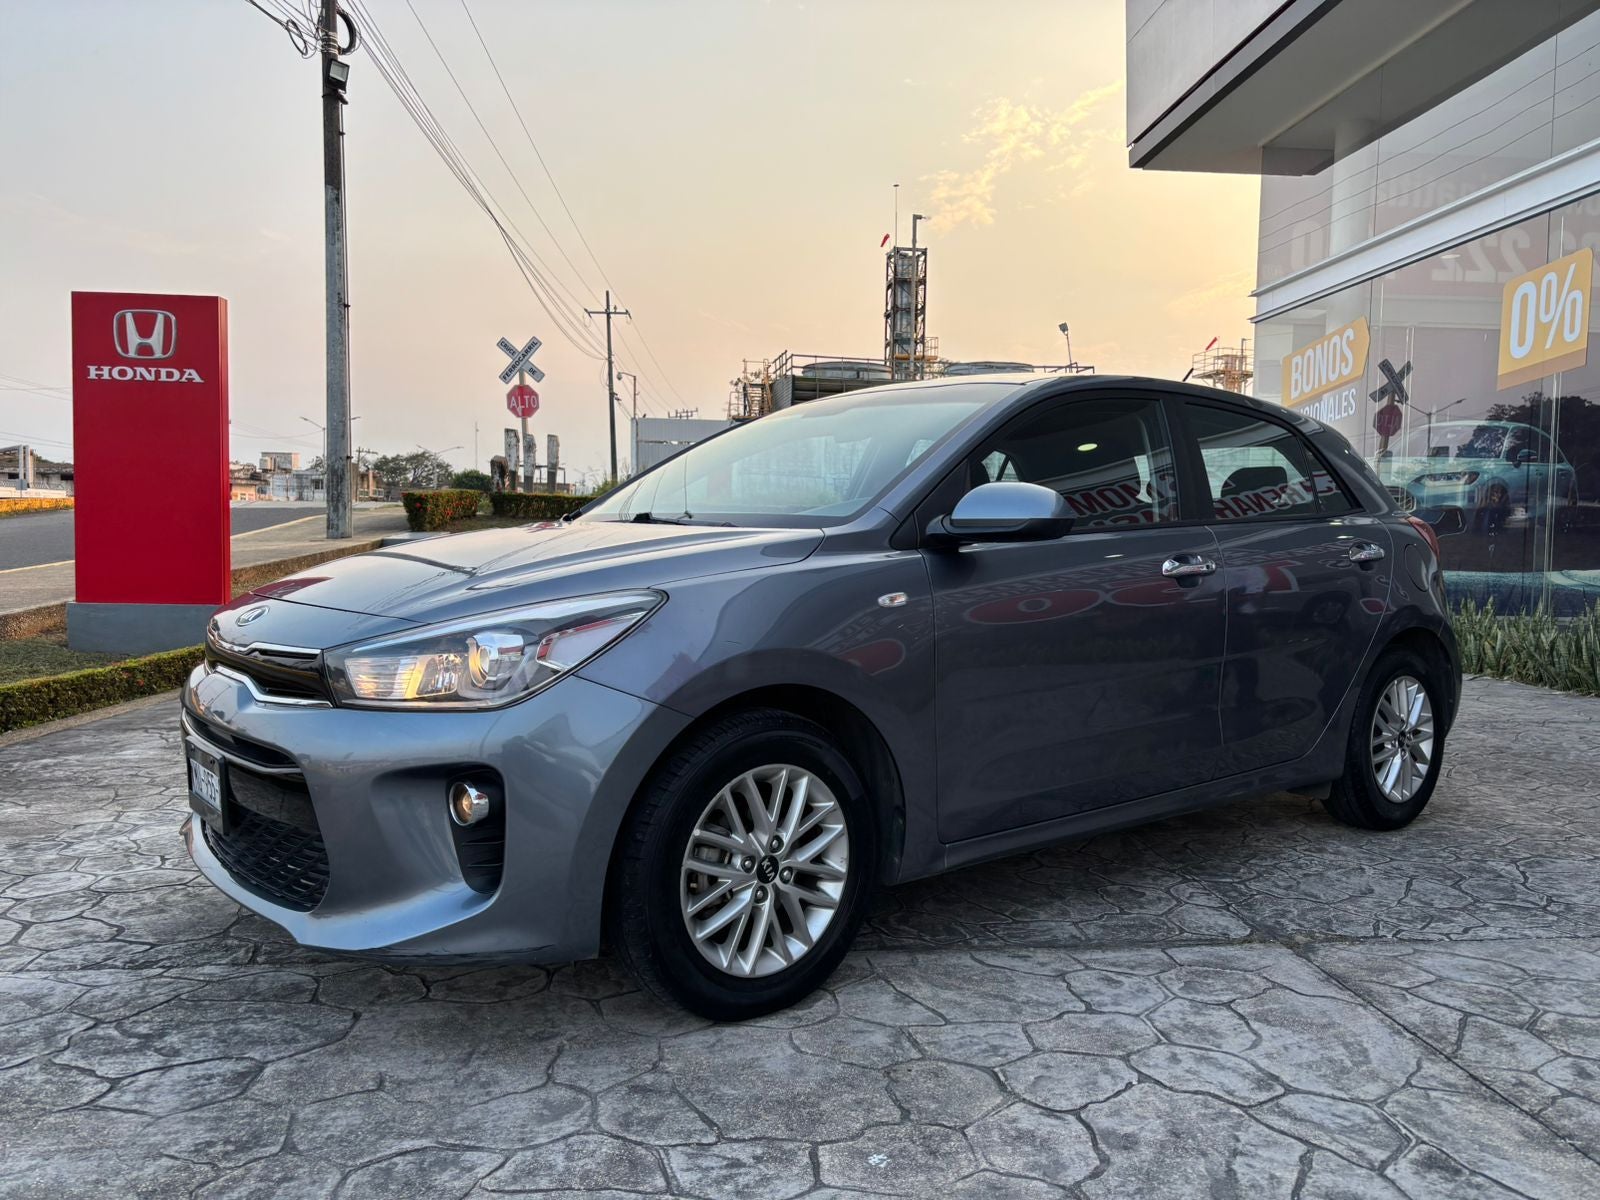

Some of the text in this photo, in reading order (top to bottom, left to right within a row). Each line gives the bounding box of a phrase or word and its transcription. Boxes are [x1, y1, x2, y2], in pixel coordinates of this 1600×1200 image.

[1510, 262, 1583, 359] 0%
[500, 340, 517, 357] CRUCE
[502, 340, 539, 381] FERROCARRIL
[87, 365, 204, 383] HONDA
[1291, 328, 1354, 400] BONOS
[509, 395, 538, 409] ALTO
